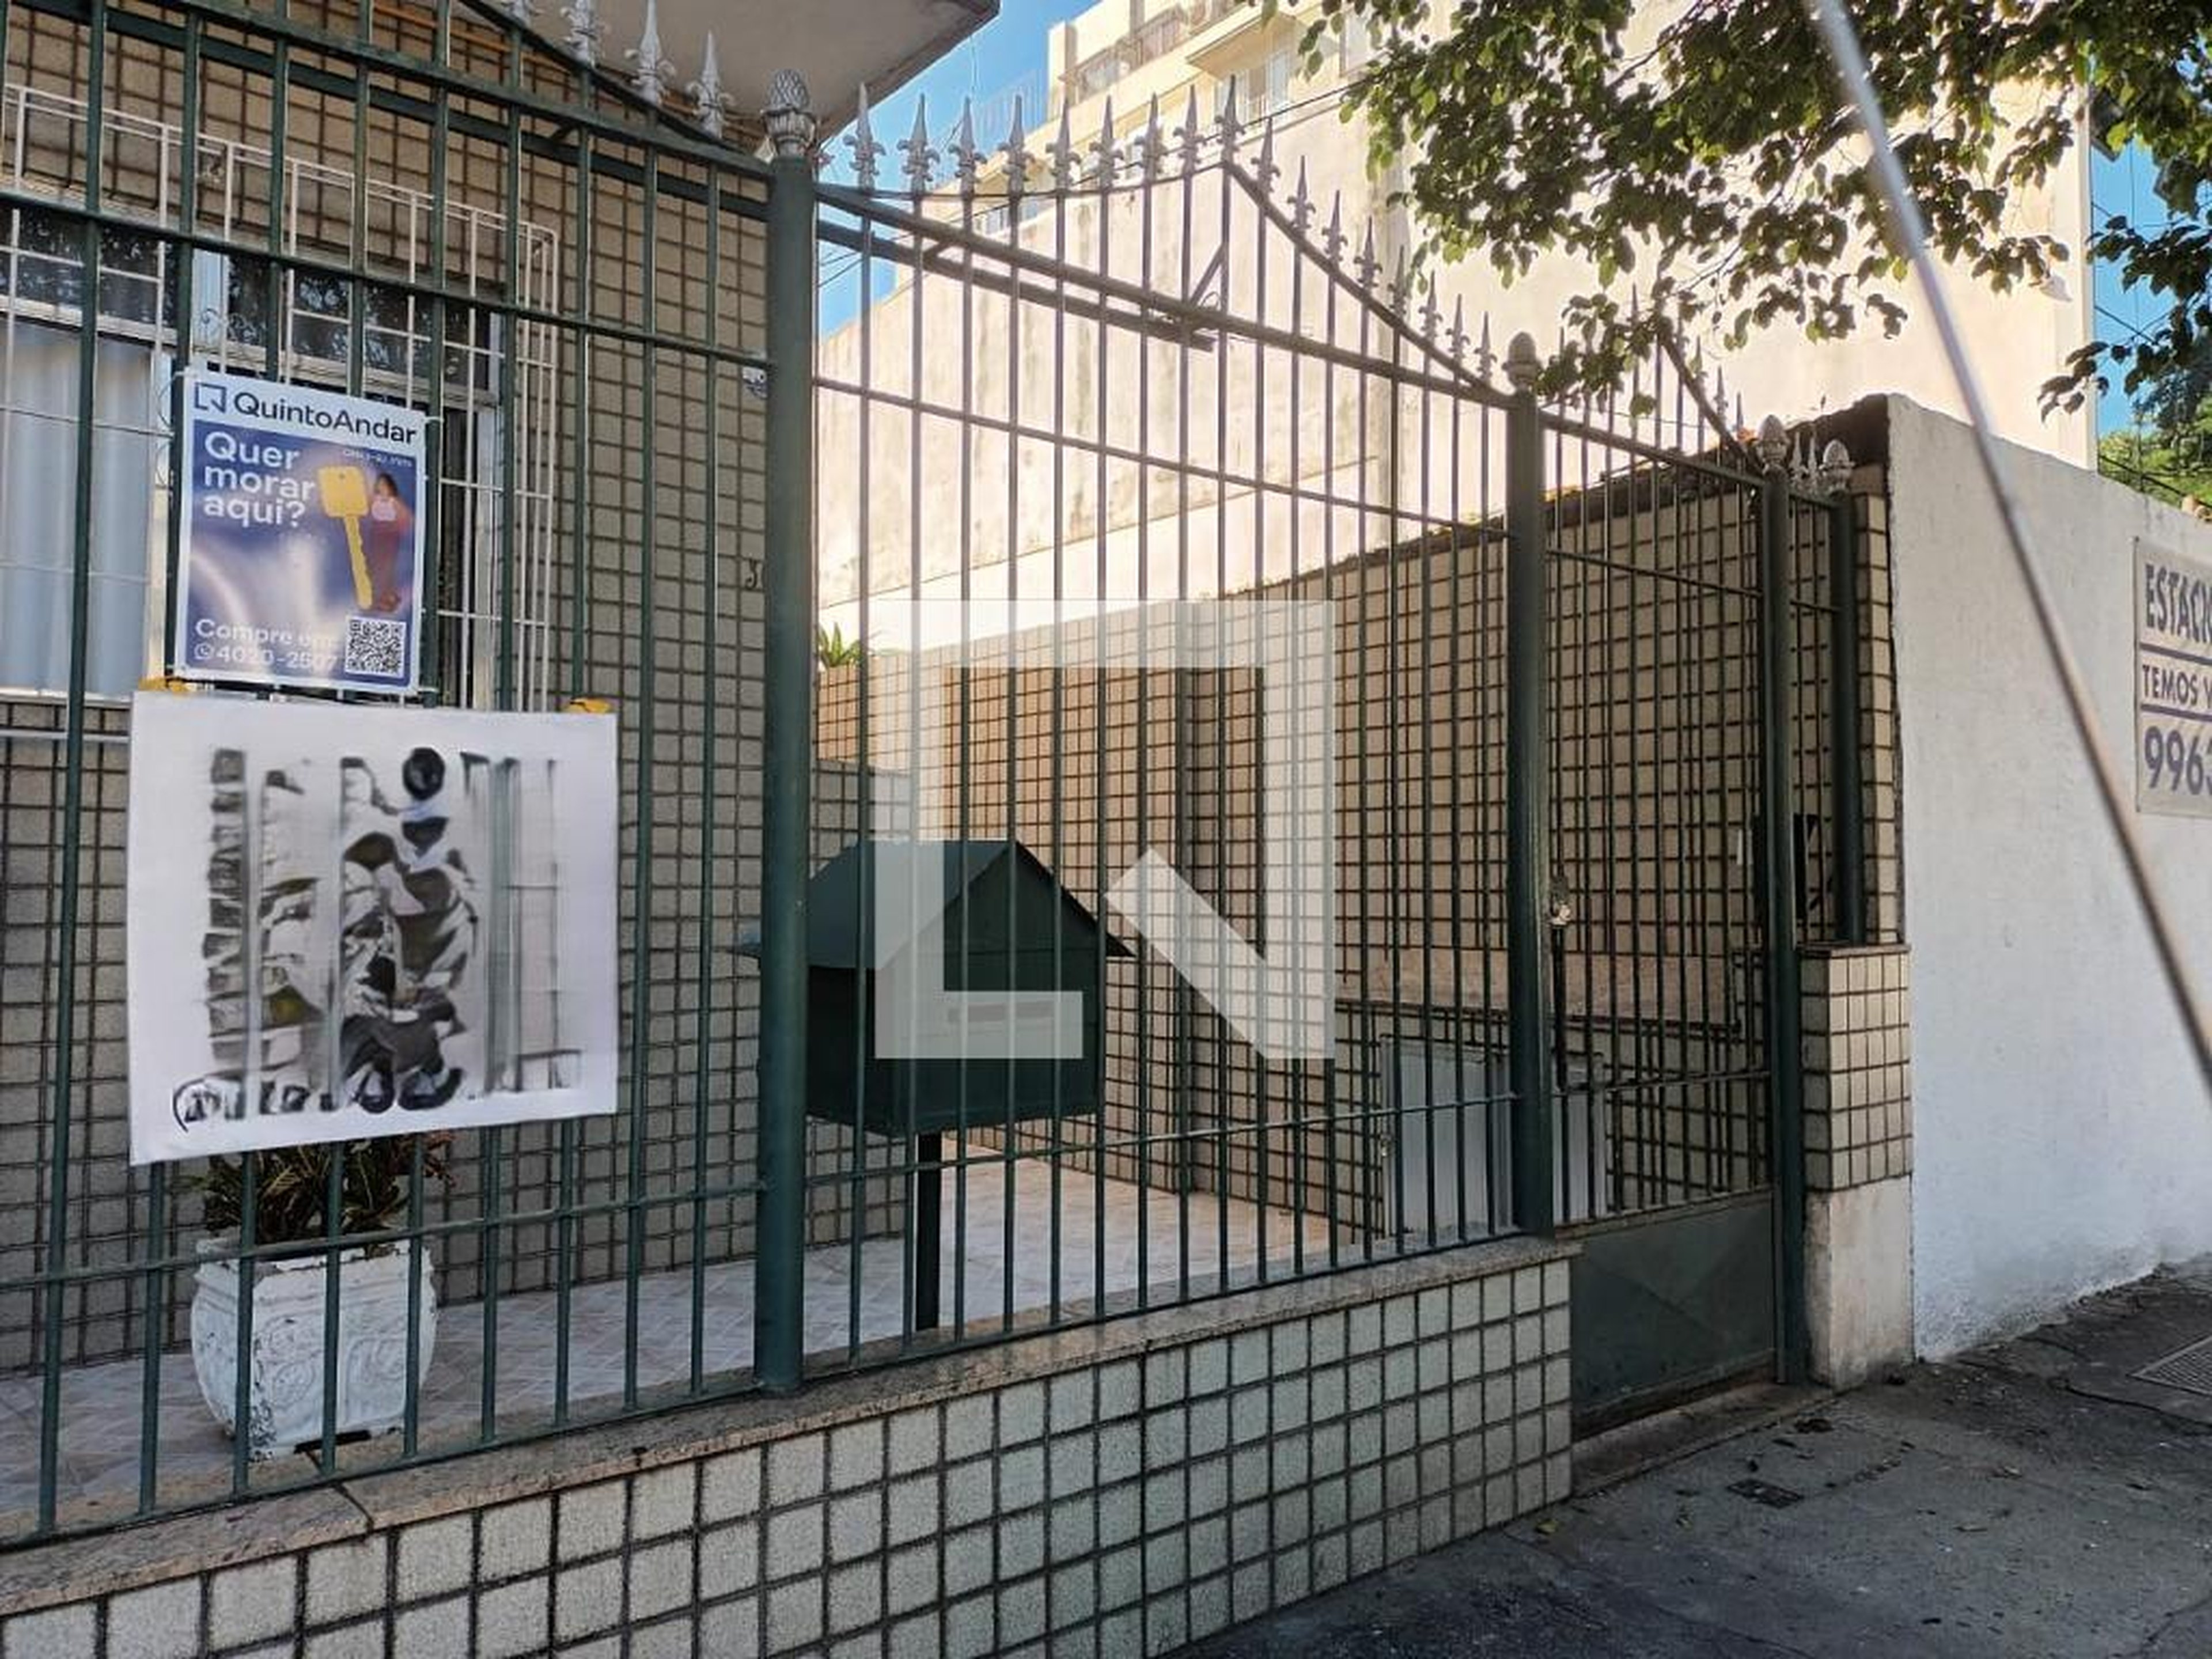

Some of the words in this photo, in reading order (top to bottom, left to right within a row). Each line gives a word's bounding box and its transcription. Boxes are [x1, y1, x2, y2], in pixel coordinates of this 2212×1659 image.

[234, 392, 416, 444] QuintoAndar
[204, 431, 300, 469] Quer
[204, 465, 315, 502] morar
[203, 496, 305, 527] aqui?
[195, 619, 293, 645] Compre
[2142, 665, 2198, 706] TEMOS
